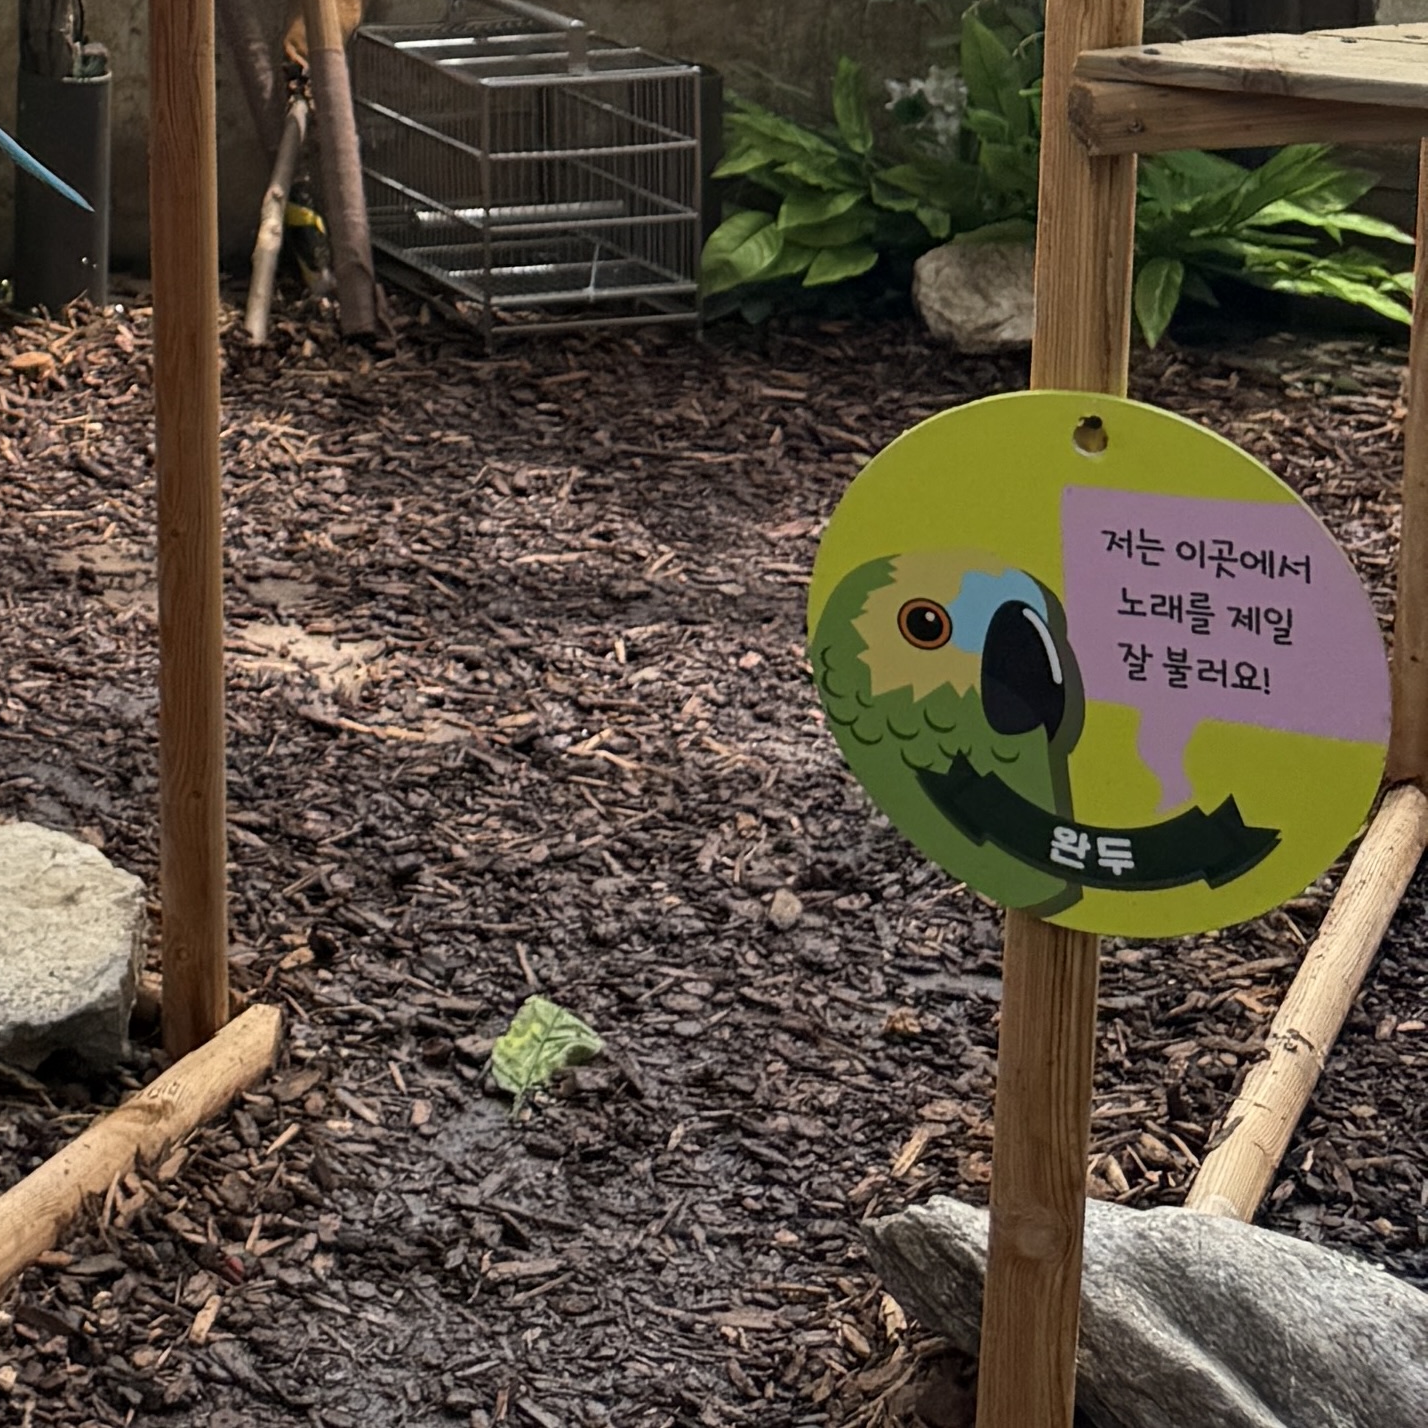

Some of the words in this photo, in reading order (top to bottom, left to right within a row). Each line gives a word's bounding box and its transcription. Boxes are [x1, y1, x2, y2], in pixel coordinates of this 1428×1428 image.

[1101, 527, 1165, 566] 저는
[1175, 539, 1312, 584] 이곳에서
[1117, 587, 1215, 635] 노래를
[1226, 606, 1293, 645] 제일
[1117, 642, 1154, 681] 잘
[1162, 646, 1271, 695] 불러요!
[1050, 826, 1135, 876] 완두
